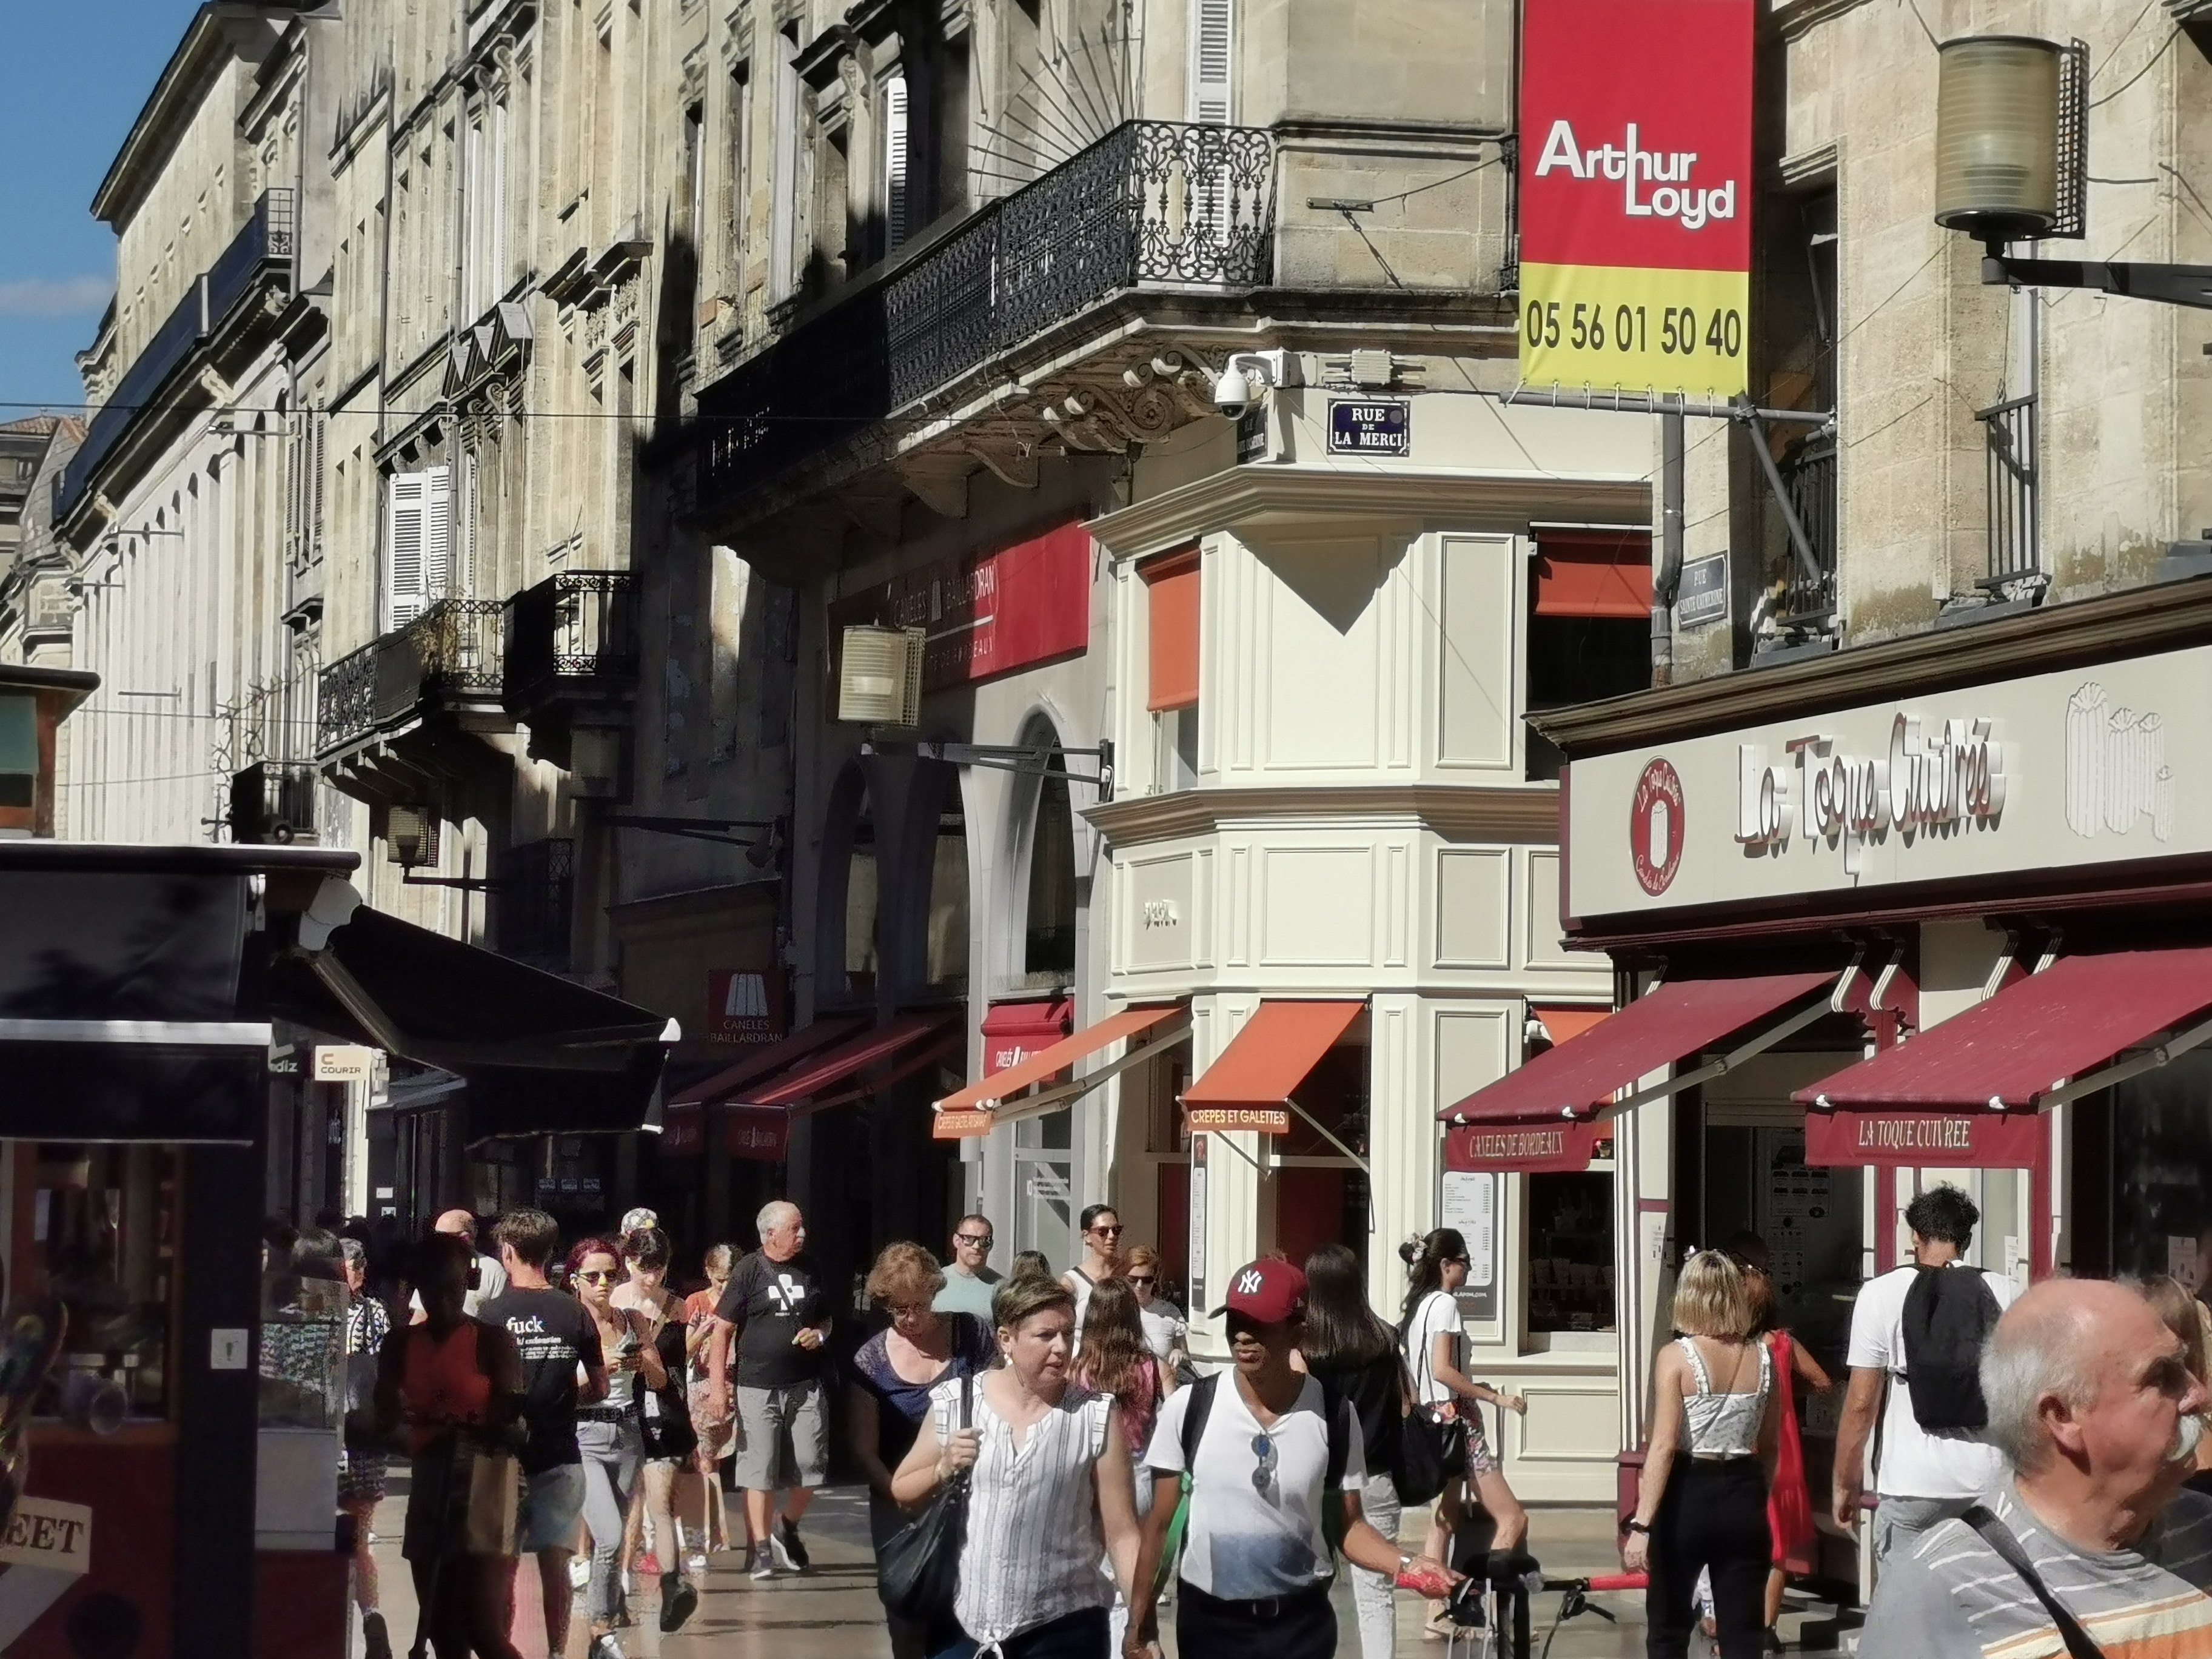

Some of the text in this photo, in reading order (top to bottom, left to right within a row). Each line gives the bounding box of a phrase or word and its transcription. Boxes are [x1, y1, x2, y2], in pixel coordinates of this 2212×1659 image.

[1535, 119, 1697, 181] Arthur
[1626, 179, 1735, 229] Loyd
[1526, 300, 1741, 357] 05 56 01 50 40
[1351, 407, 1386, 422] RUE
[1335, 431, 1403, 447] LA MERCI
[1694, 568, 1707, 586] RUE
[1734, 744, 1793, 844] La
[1786, 734, 1892, 875] Toque
[1191, 1110, 1285, 1125] CREPES ET GALETTES
[1506, 1133, 1518, 1156] DE
[1518, 1131, 1564, 1157] BORDEAUX
[1858, 1120, 1874, 1146] LA
[1877, 1120, 1915, 1150] TOQUE
[1238, 1270, 1262, 1293] NY
[506, 1315, 545, 1334] fuck
